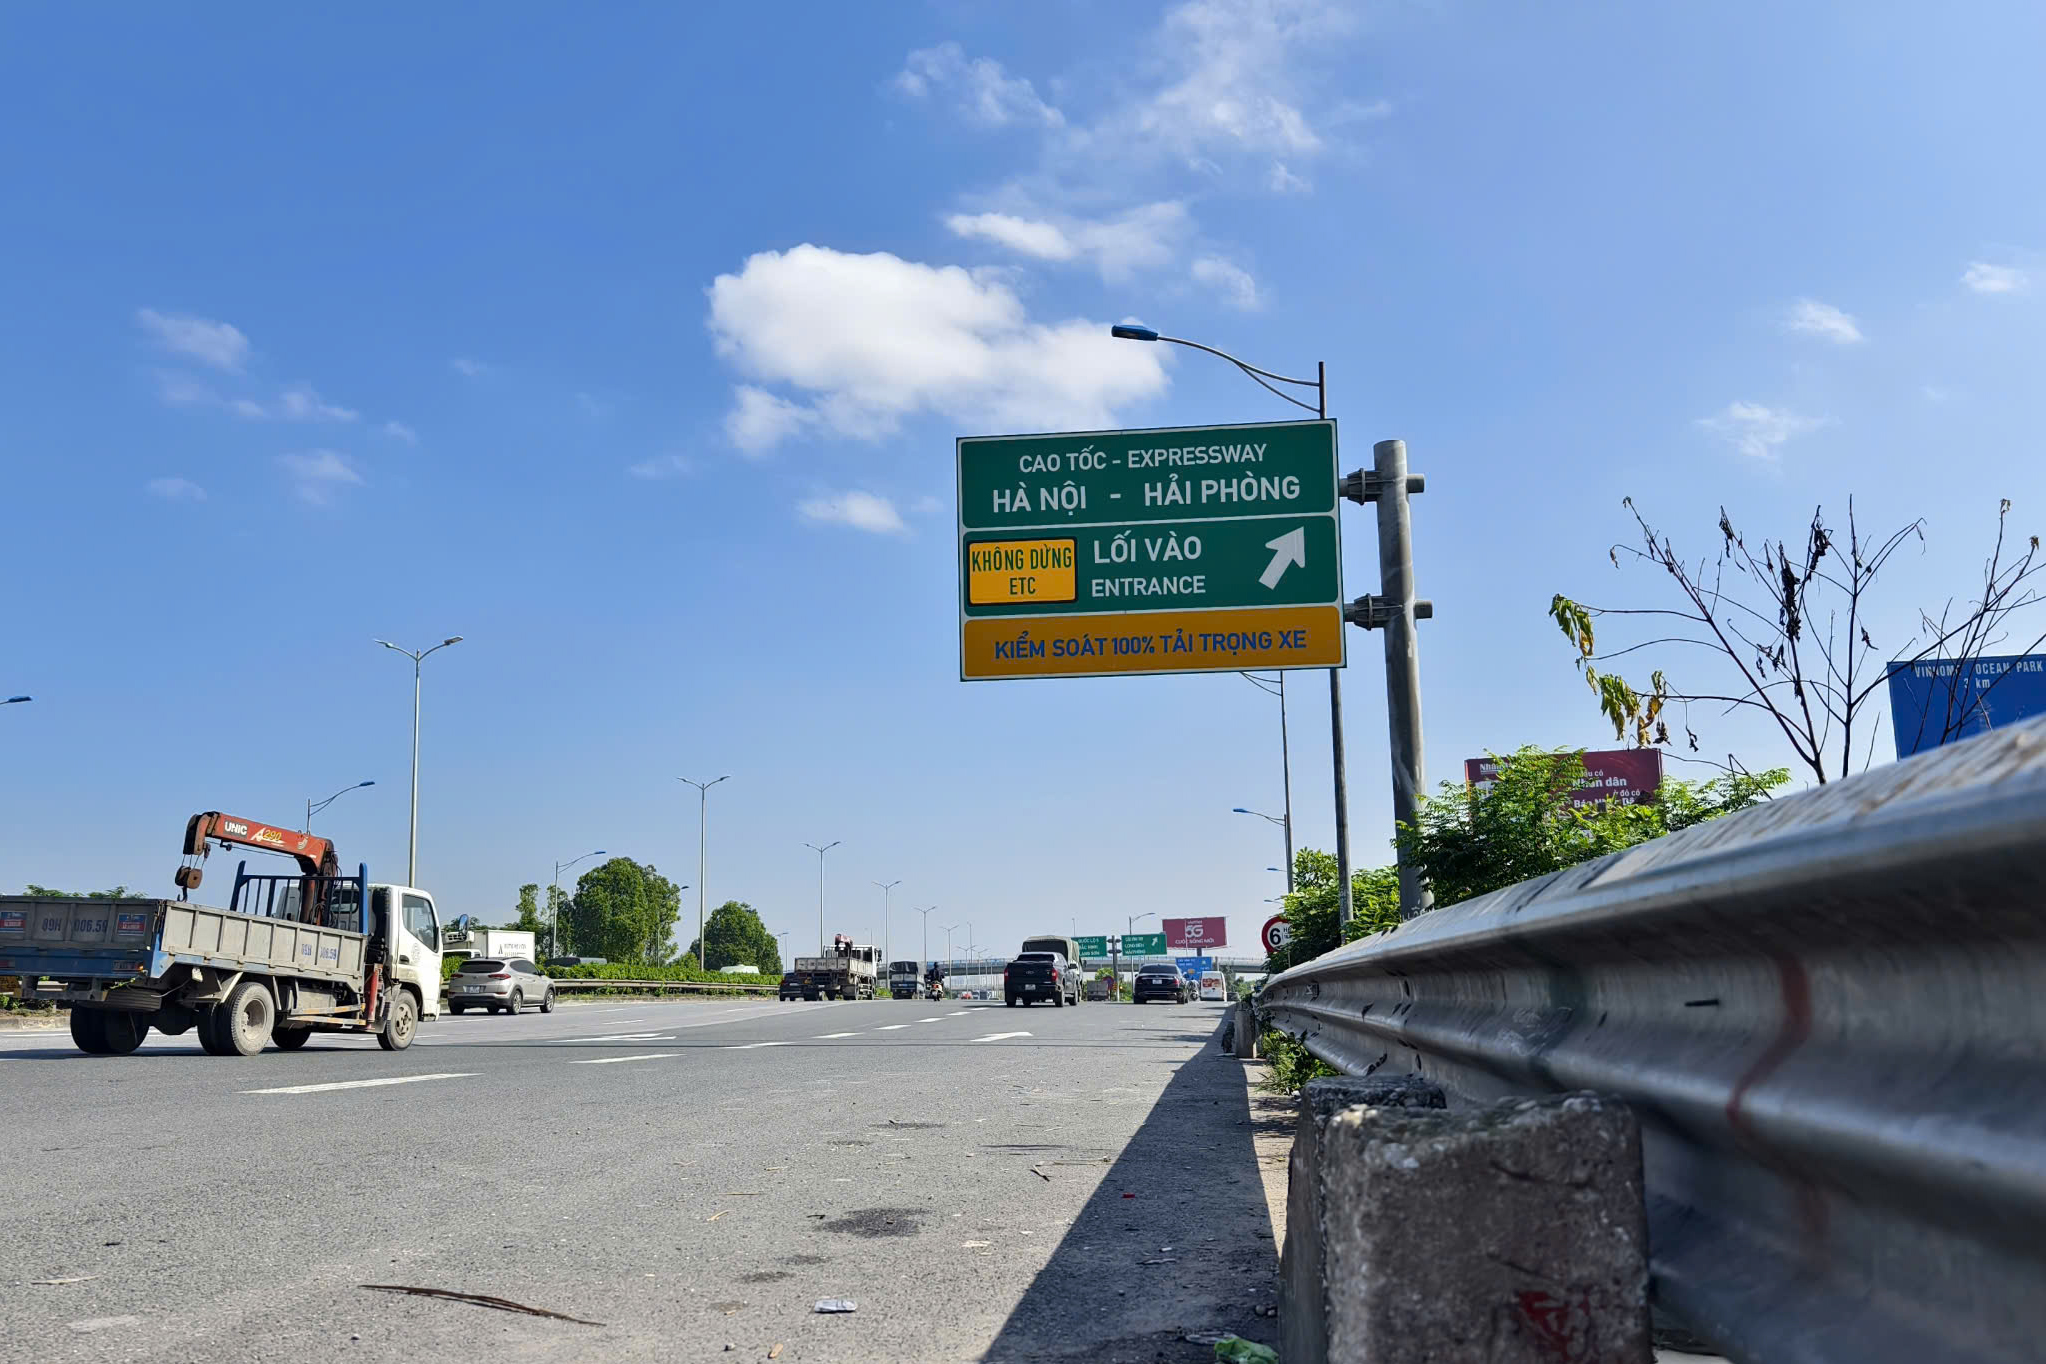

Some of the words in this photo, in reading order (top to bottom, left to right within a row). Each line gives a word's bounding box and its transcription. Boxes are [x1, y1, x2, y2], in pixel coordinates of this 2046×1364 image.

[1019, 454, 1061, 473] CAO
[1066, 445, 1107, 471] TỐC
[1128, 443, 1267, 468] EXPRESSWAY
[993, 481, 1031, 513] HÀ
[1040, 480, 1086, 516] NỘI
[1144, 473, 1191, 506] HẢI
[1201, 471, 1300, 503] PHÒNG
[1094, 530, 1136, 564] LỐI
[1144, 531, 1201, 561] VÀO
[972, 546, 1024, 572] KHÔNG
[1030, 544, 1072, 570] DỪNG
[1009, 577, 1036, 595] ETC
[1091, 575, 1206, 598] ENTRANCE
[995, 630, 1045, 659] KIỂM
[1052, 633, 1107, 657] SOÁT
[1111, 635, 1155, 656] 100%
[1159, 628, 1193, 653] TẢI
[1199, 631, 1272, 656] TRỌNG
[1278, 630, 1307, 649] XE
[1975, 662, 2011, 675] OCEAN
[2016, 660, 2044, 673] PARK
[1975, 677, 1991, 689] km
[1605, 776, 1627, 787] dân
[224, 821, 248, 835] UNIC
[1185, 925, 1203, 938] 5G
